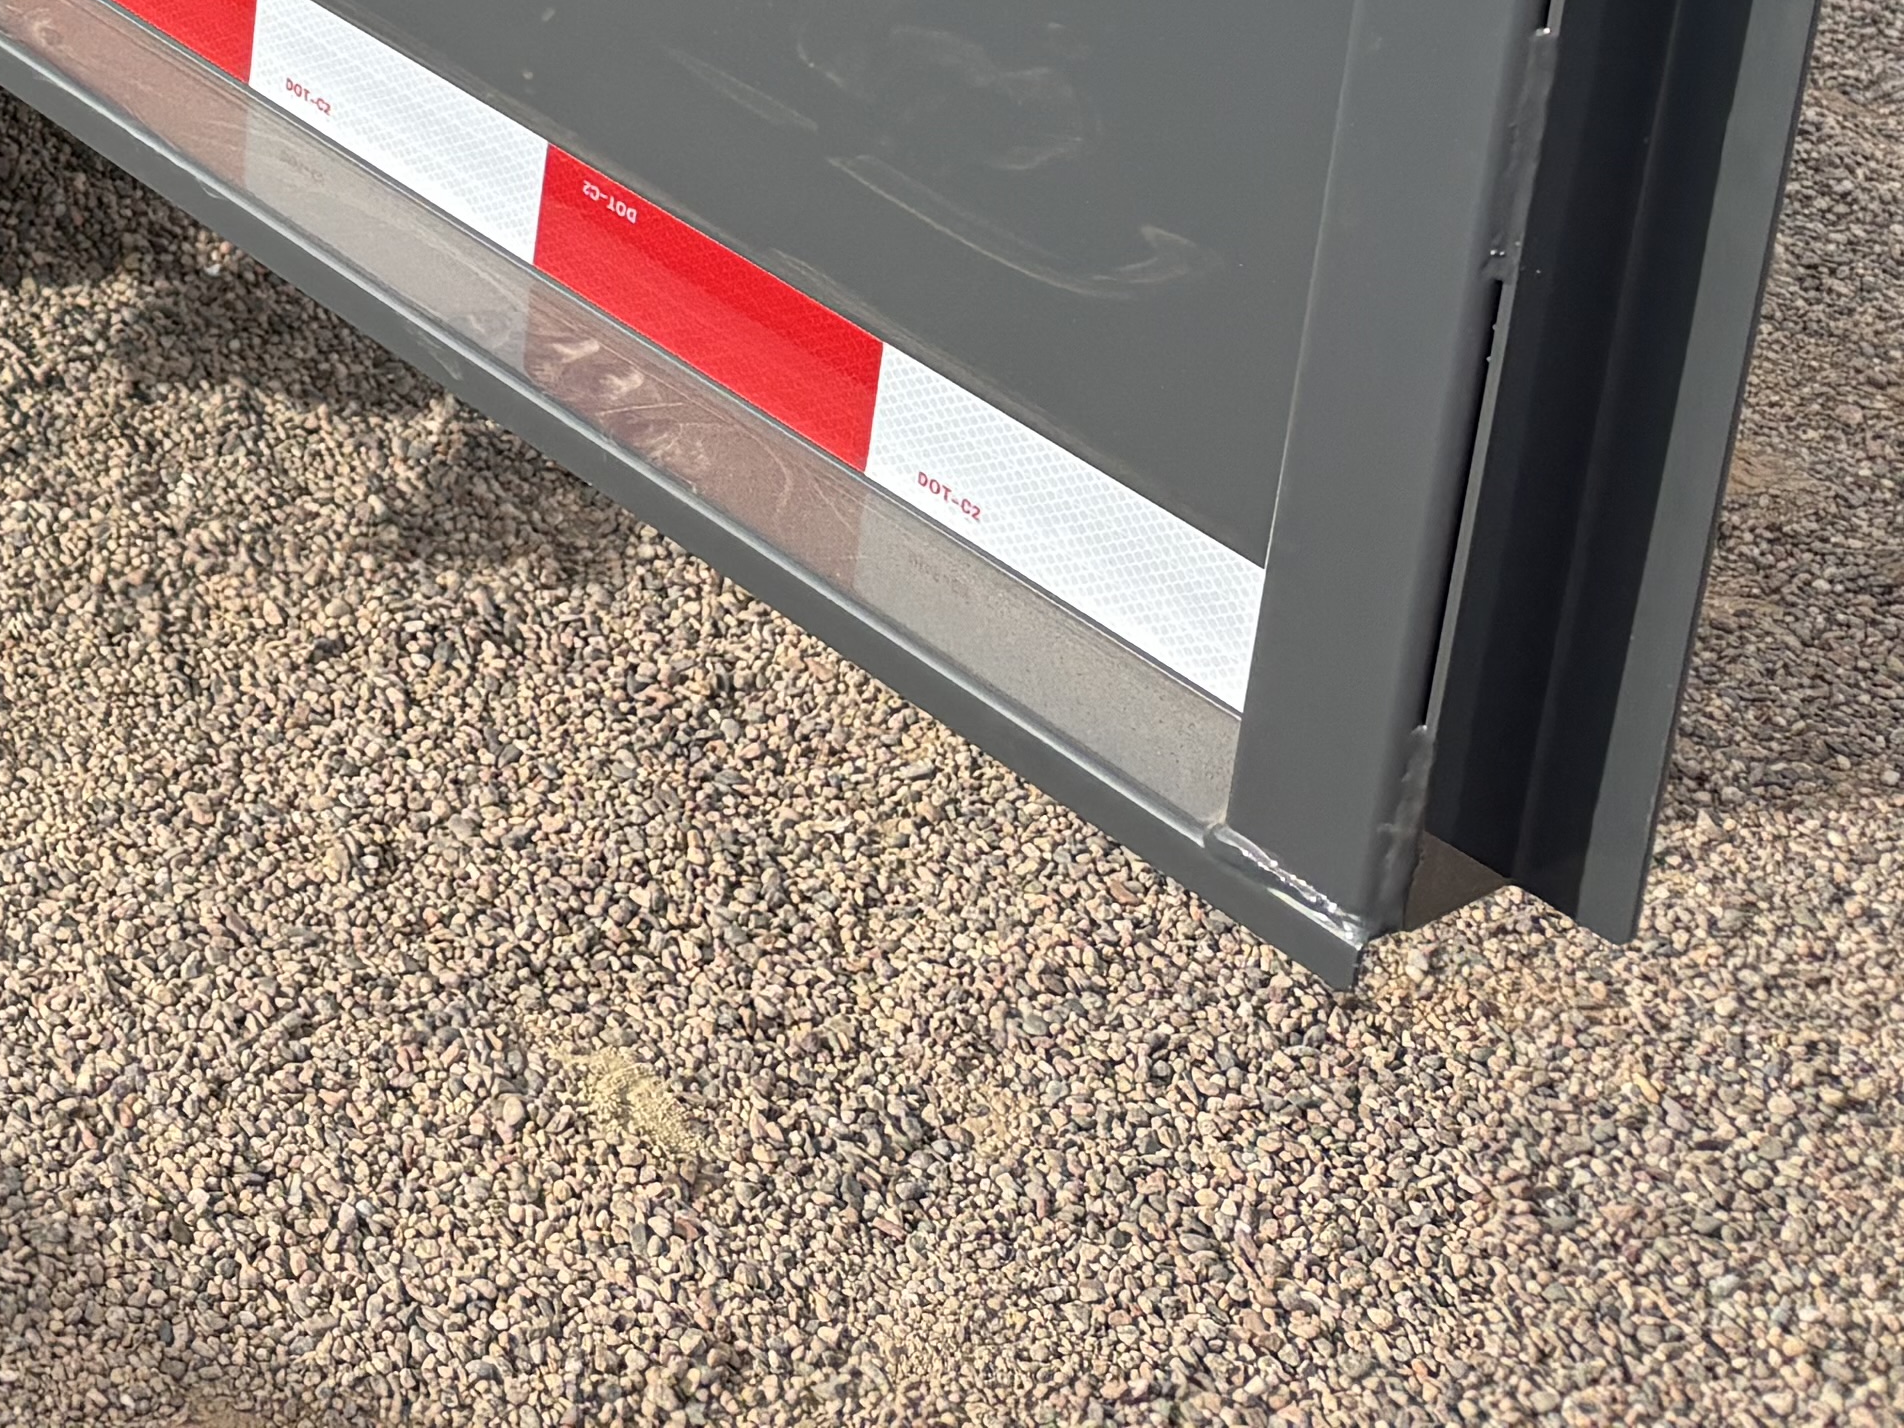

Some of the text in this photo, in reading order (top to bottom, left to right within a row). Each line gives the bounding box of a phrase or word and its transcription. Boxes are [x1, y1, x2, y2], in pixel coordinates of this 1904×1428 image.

[285, 77, 331, 116] DOT-C2
[583, 179, 638, 224] DOT-C2
[918, 470, 982, 524] DOT-C2
